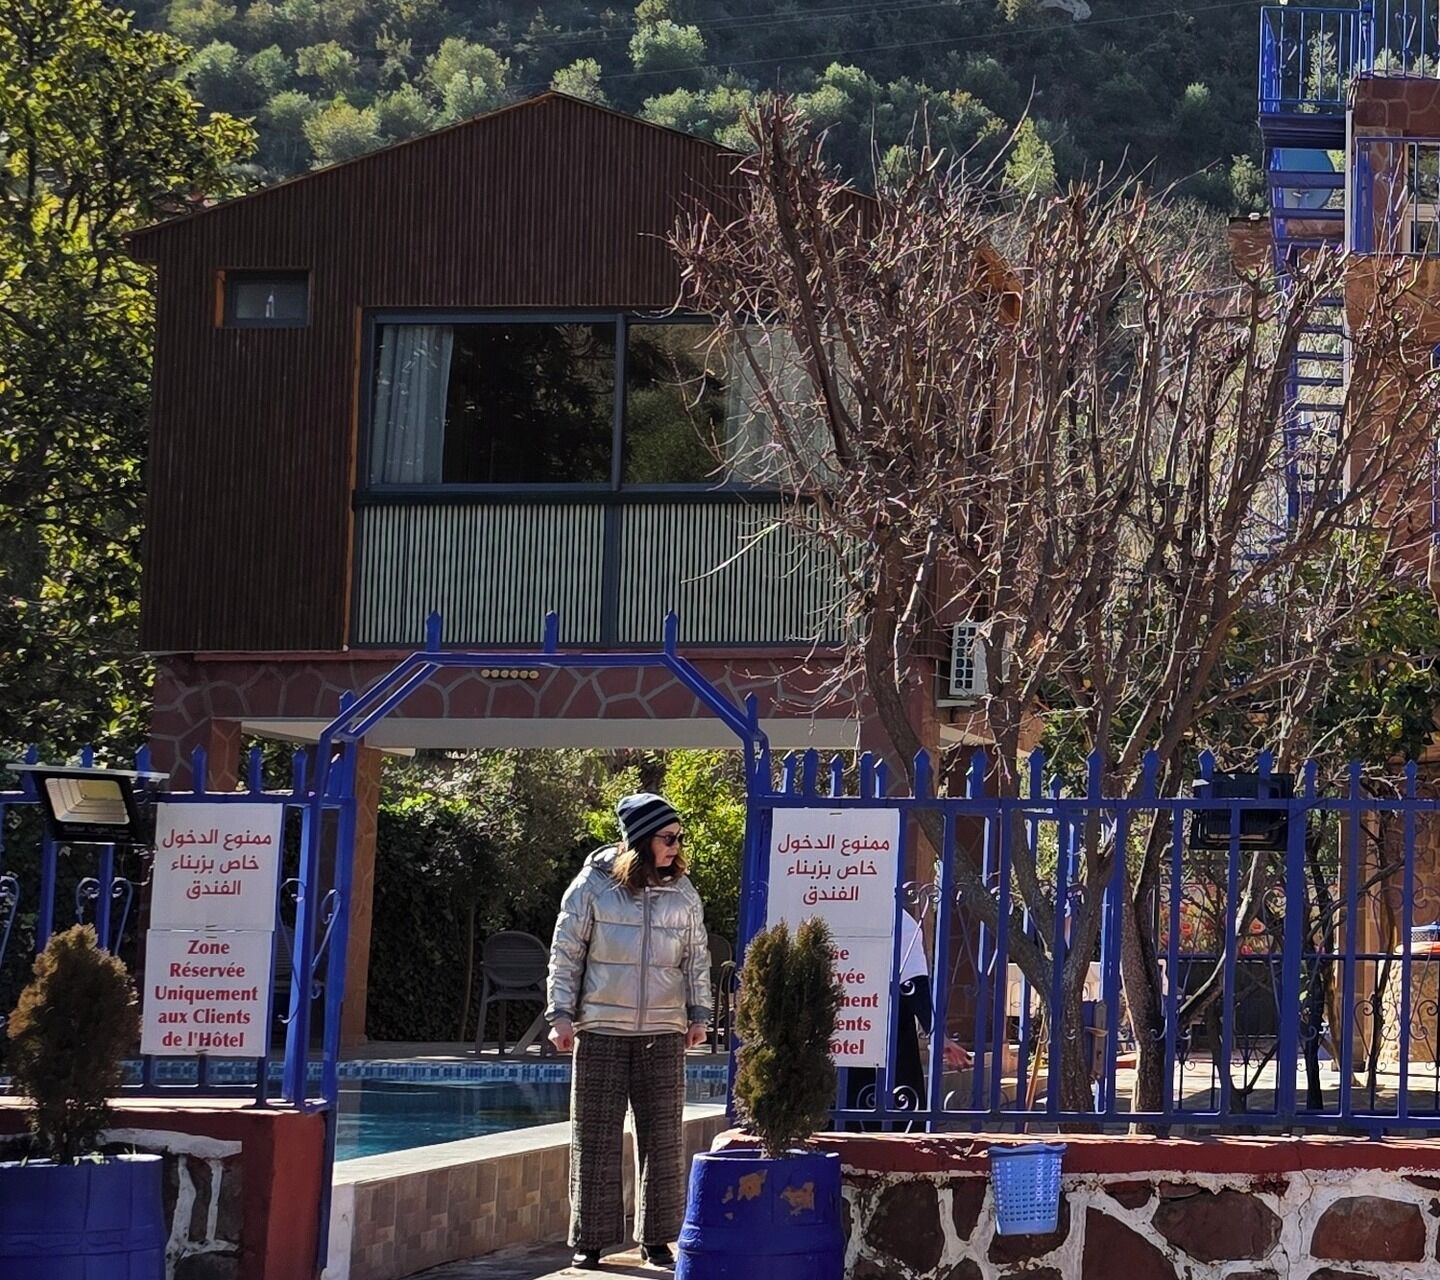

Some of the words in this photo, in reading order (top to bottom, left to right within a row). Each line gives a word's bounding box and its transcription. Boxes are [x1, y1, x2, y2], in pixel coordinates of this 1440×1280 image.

[162, 829, 218, 848] الدخول
[223, 830, 272, 851] ممنوع
[778, 834, 835, 854] الدخول
[841, 835, 890, 856] ممنوع
[171, 855, 214, 874] بزبناء
[219, 855, 259, 874] خاص
[787, 859, 831, 879] بزبناء
[836, 860, 877, 880] خاص
[186, 880, 241, 899] الفندق
[803, 886, 859, 905] الفندق
[187, 940, 230, 954] Zone
[170, 961, 245, 977] Réservée
[155, 985, 258, 1005] Uniquement
[158, 1012, 188, 1024] aux
[193, 1008, 250, 1024] Clients
[837, 1016, 872, 1031] ents
[162, 1031, 183, 1046] de
[188, 1031, 244, 1047] l'Hôtel
[832, 1039, 865, 1055] ôtel
